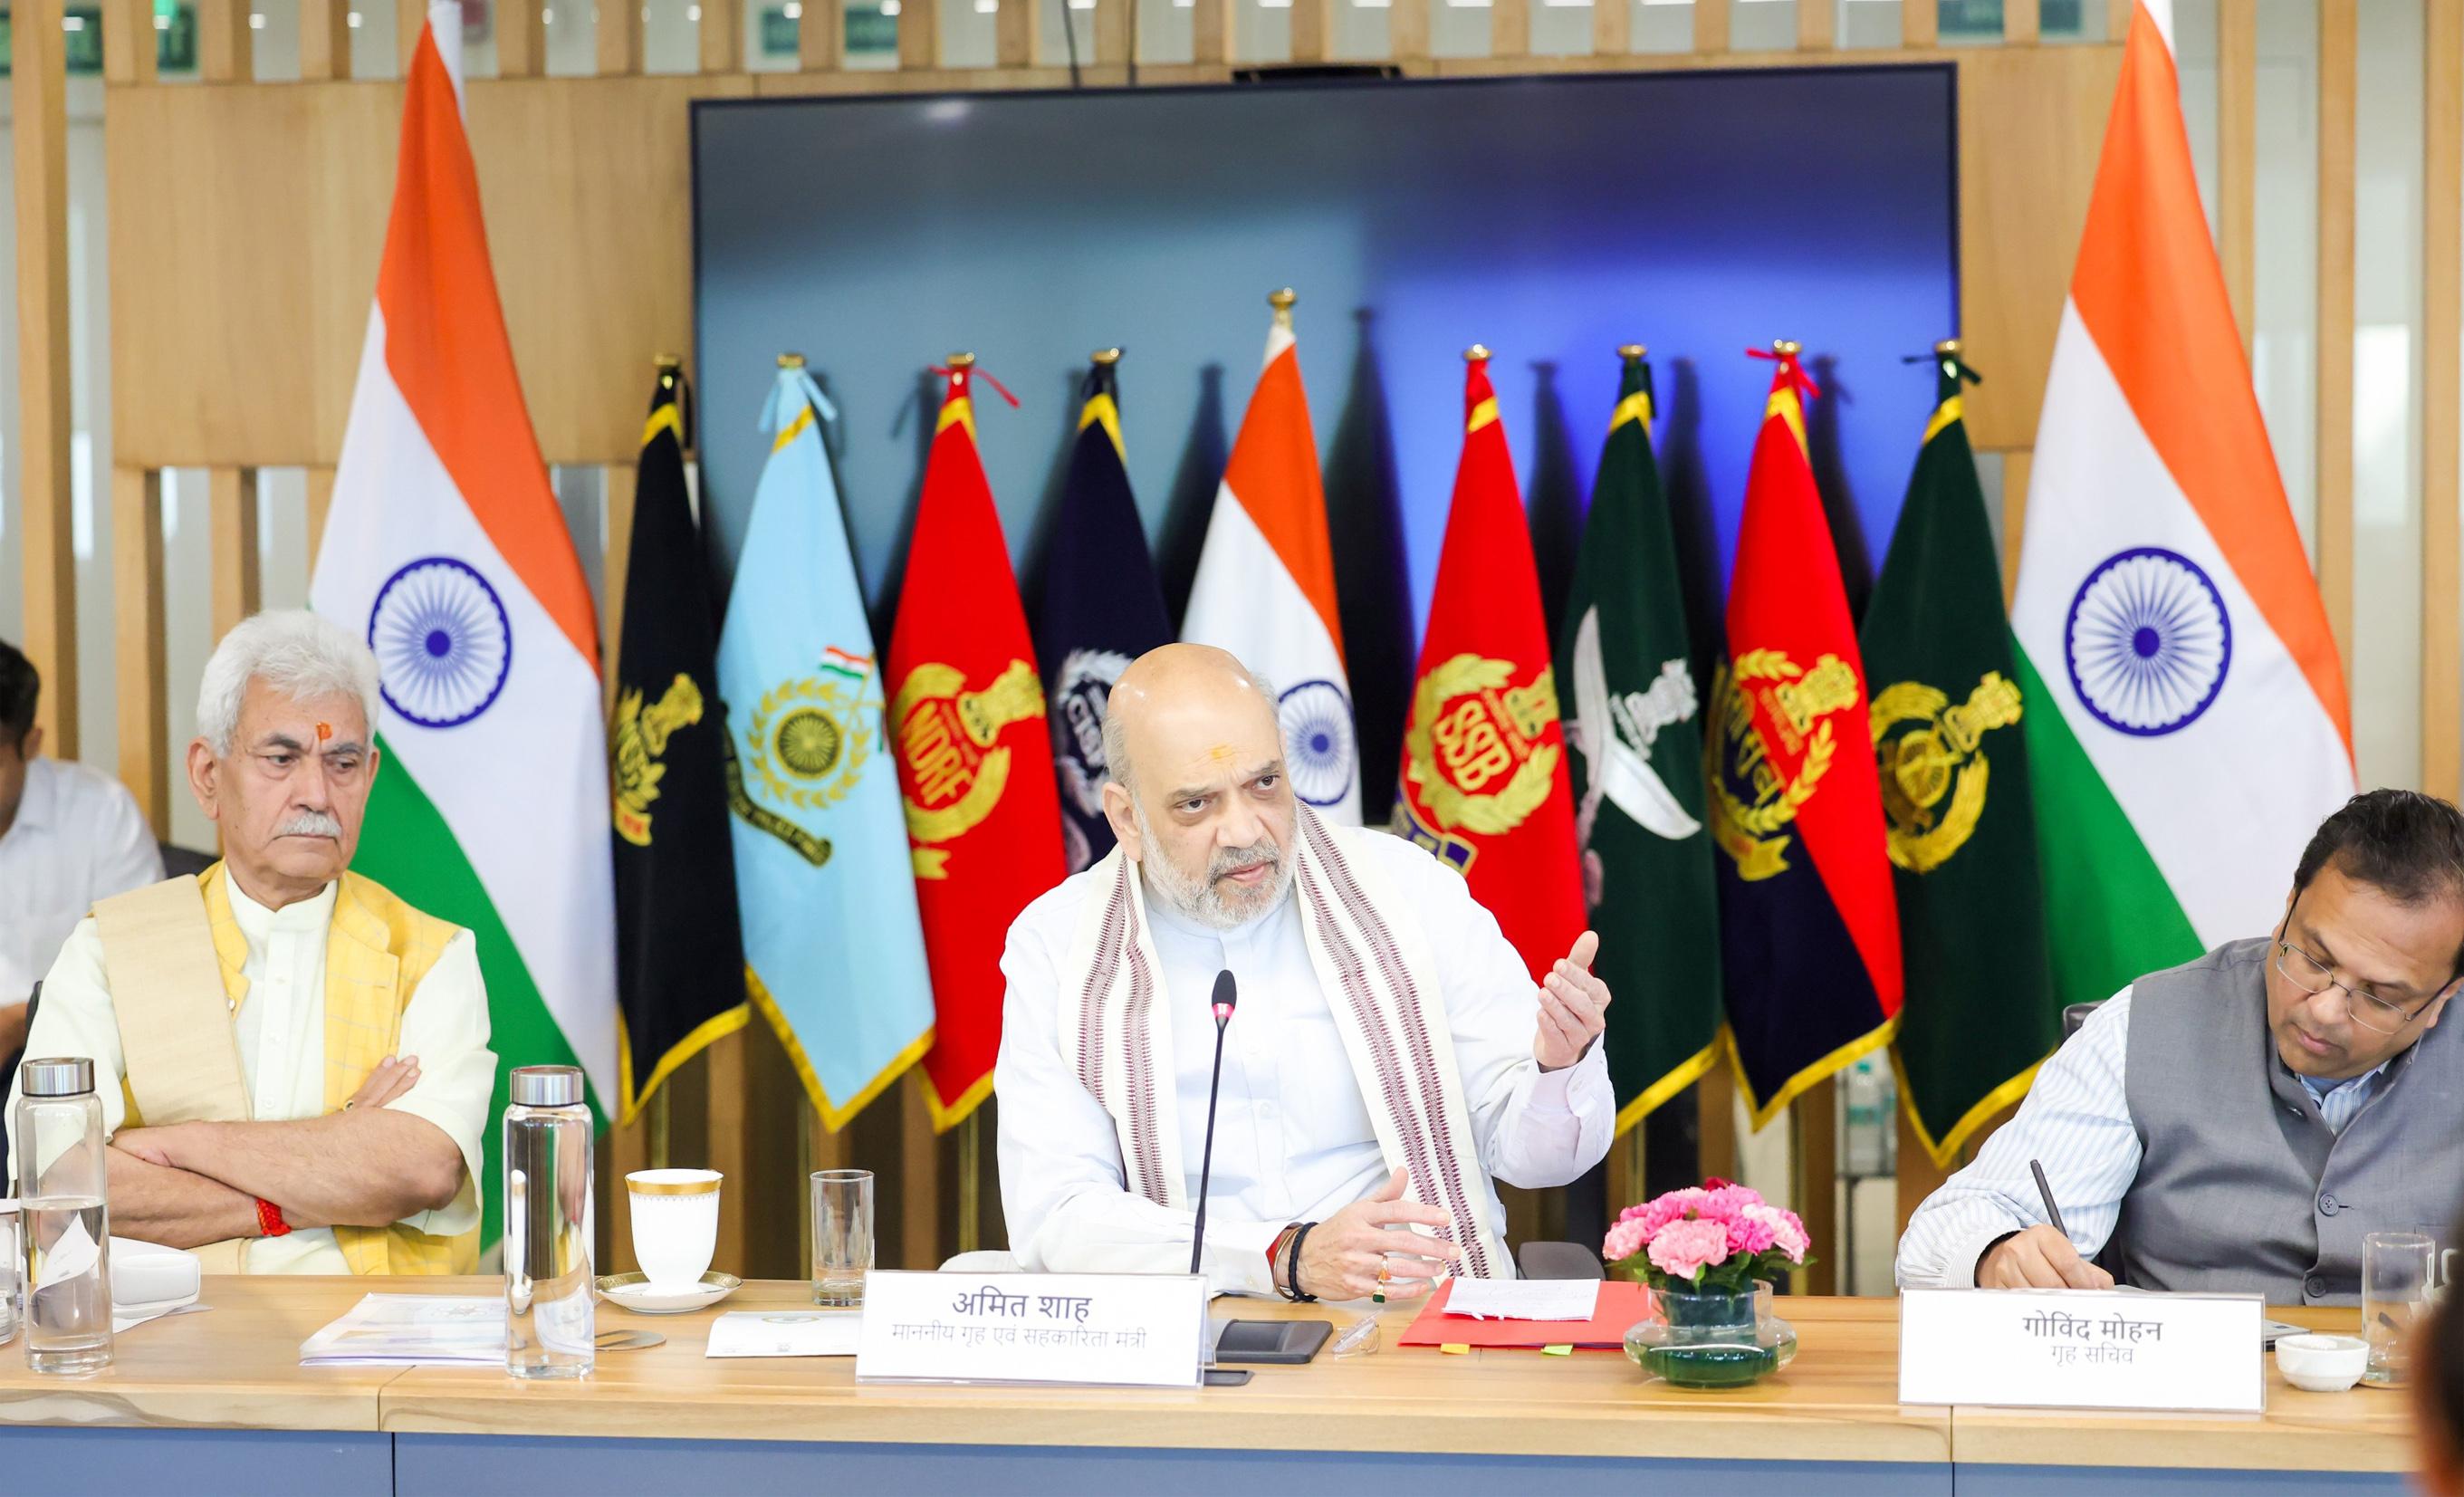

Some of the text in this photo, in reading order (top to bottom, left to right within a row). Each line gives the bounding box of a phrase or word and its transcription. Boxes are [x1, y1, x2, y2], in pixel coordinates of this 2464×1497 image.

[902, 701, 973, 806] NDRF
[1434, 699, 1511, 791] SSB
[953, 1285, 1092, 1323] अमित शाह
[892, 1319, 1147, 1348] माननीय गृह एवं सहकारिता मंत्री
[2023, 1310, 2163, 1342] गोविंद मोहन
[2051, 1342, 2134, 1366] गृह सचिव
